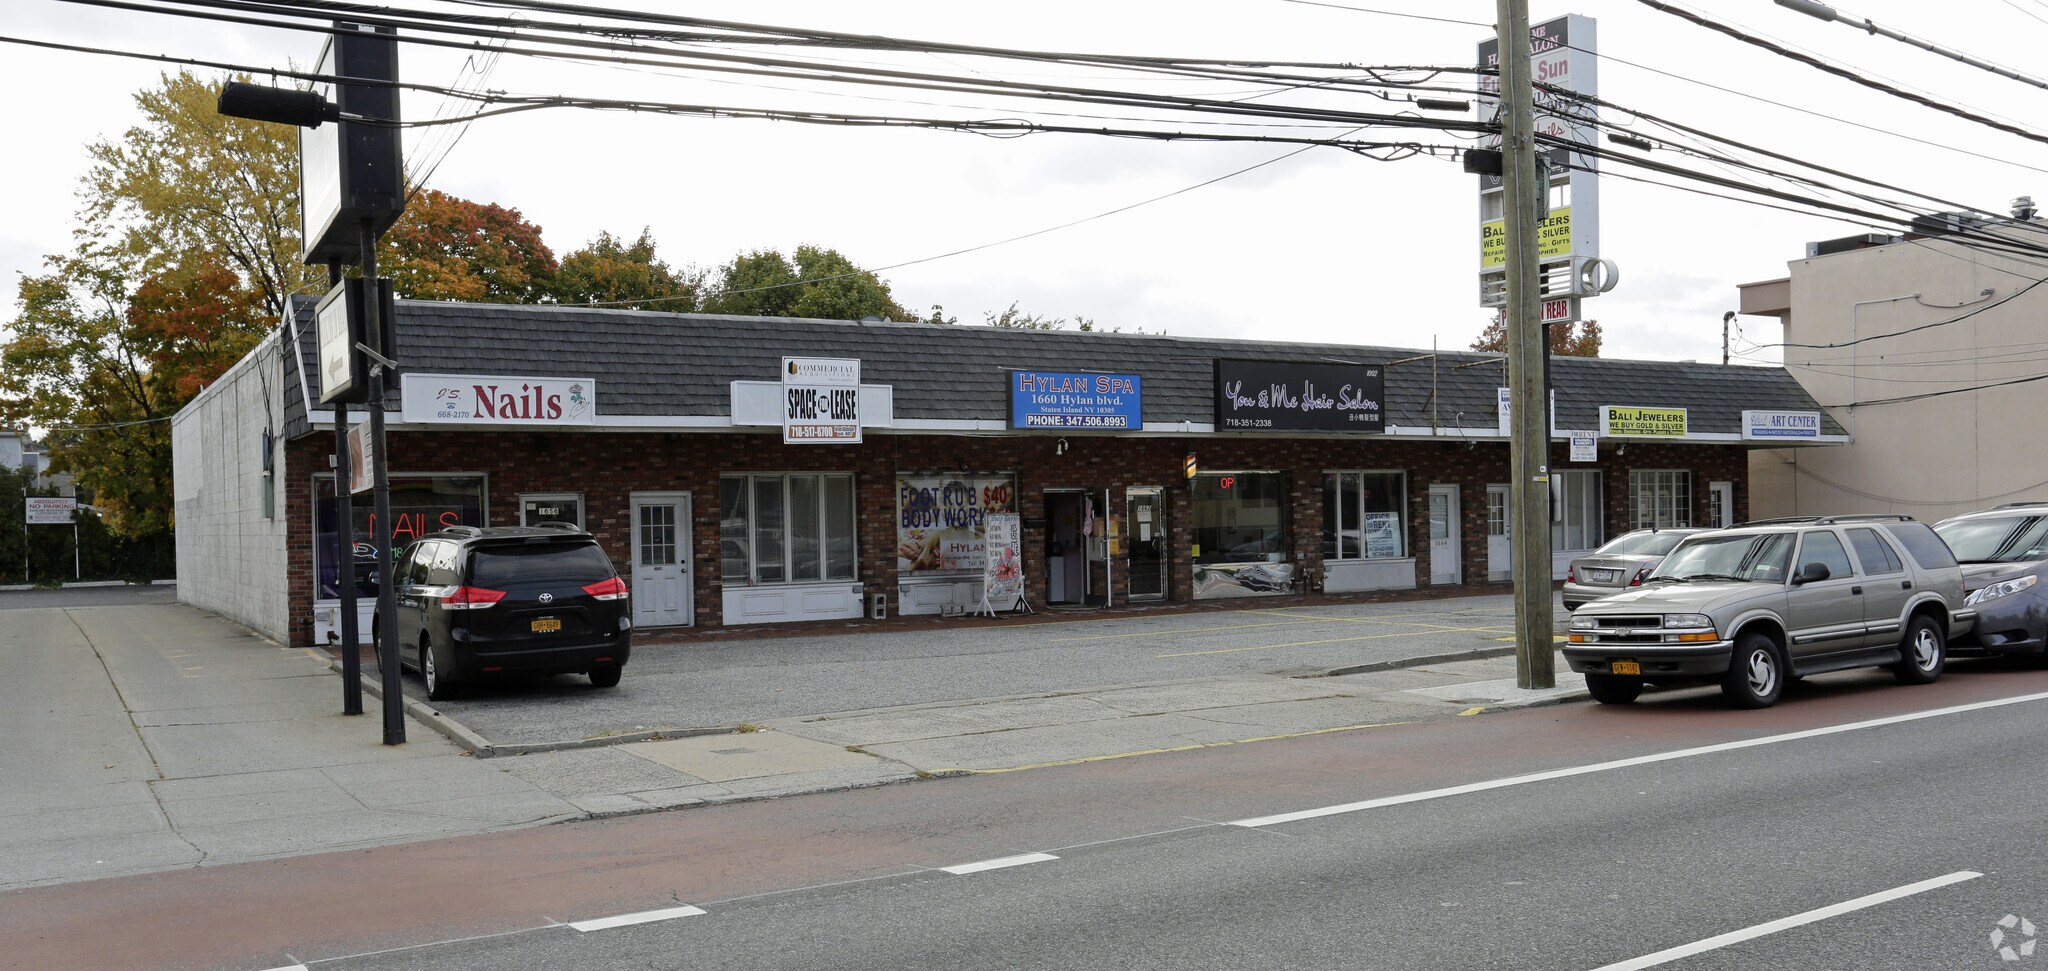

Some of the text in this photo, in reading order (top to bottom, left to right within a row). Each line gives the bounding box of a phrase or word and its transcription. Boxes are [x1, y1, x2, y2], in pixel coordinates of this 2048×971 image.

[1531, 26, 1546, 37] ME
[1529, 35, 1559, 54] ALON
[1538, 59, 1568, 81] Sun
[1483, 226, 1505, 239] BAL
[1483, 226, 1570, 248] WE BU SILVER
[1546, 300, 1568, 319] REAR
[798, 364, 855, 374] COMMERCIAL
[1019, 373, 1134, 394] HYLAN SPA
[472, 383, 563, 420] Nails
[1031, 394, 1123, 406] 1660 Hylan blvd.
[1225, 380, 1379, 412] You & Me Hair Salon
[787, 388, 857, 420] SPACE FOR LEASE
[437, 411, 470, 419] 668-2170
[1027, 415, 1126, 427] PHONE: 347.506.8993
[1608, 409, 1684, 422] BALI JEWELERS
[1770, 415, 1786, 427] ART
[1787, 416, 1816, 428] CENTER
[1225, 419, 1272, 427] 718-351-2338
[790, 426, 833, 438] 718-517-8700
[900, 485, 1008, 507] FOOT RUB $40
[901, 508, 940, 529] BODY
[1365, 513, 1390, 521] OFFICE
